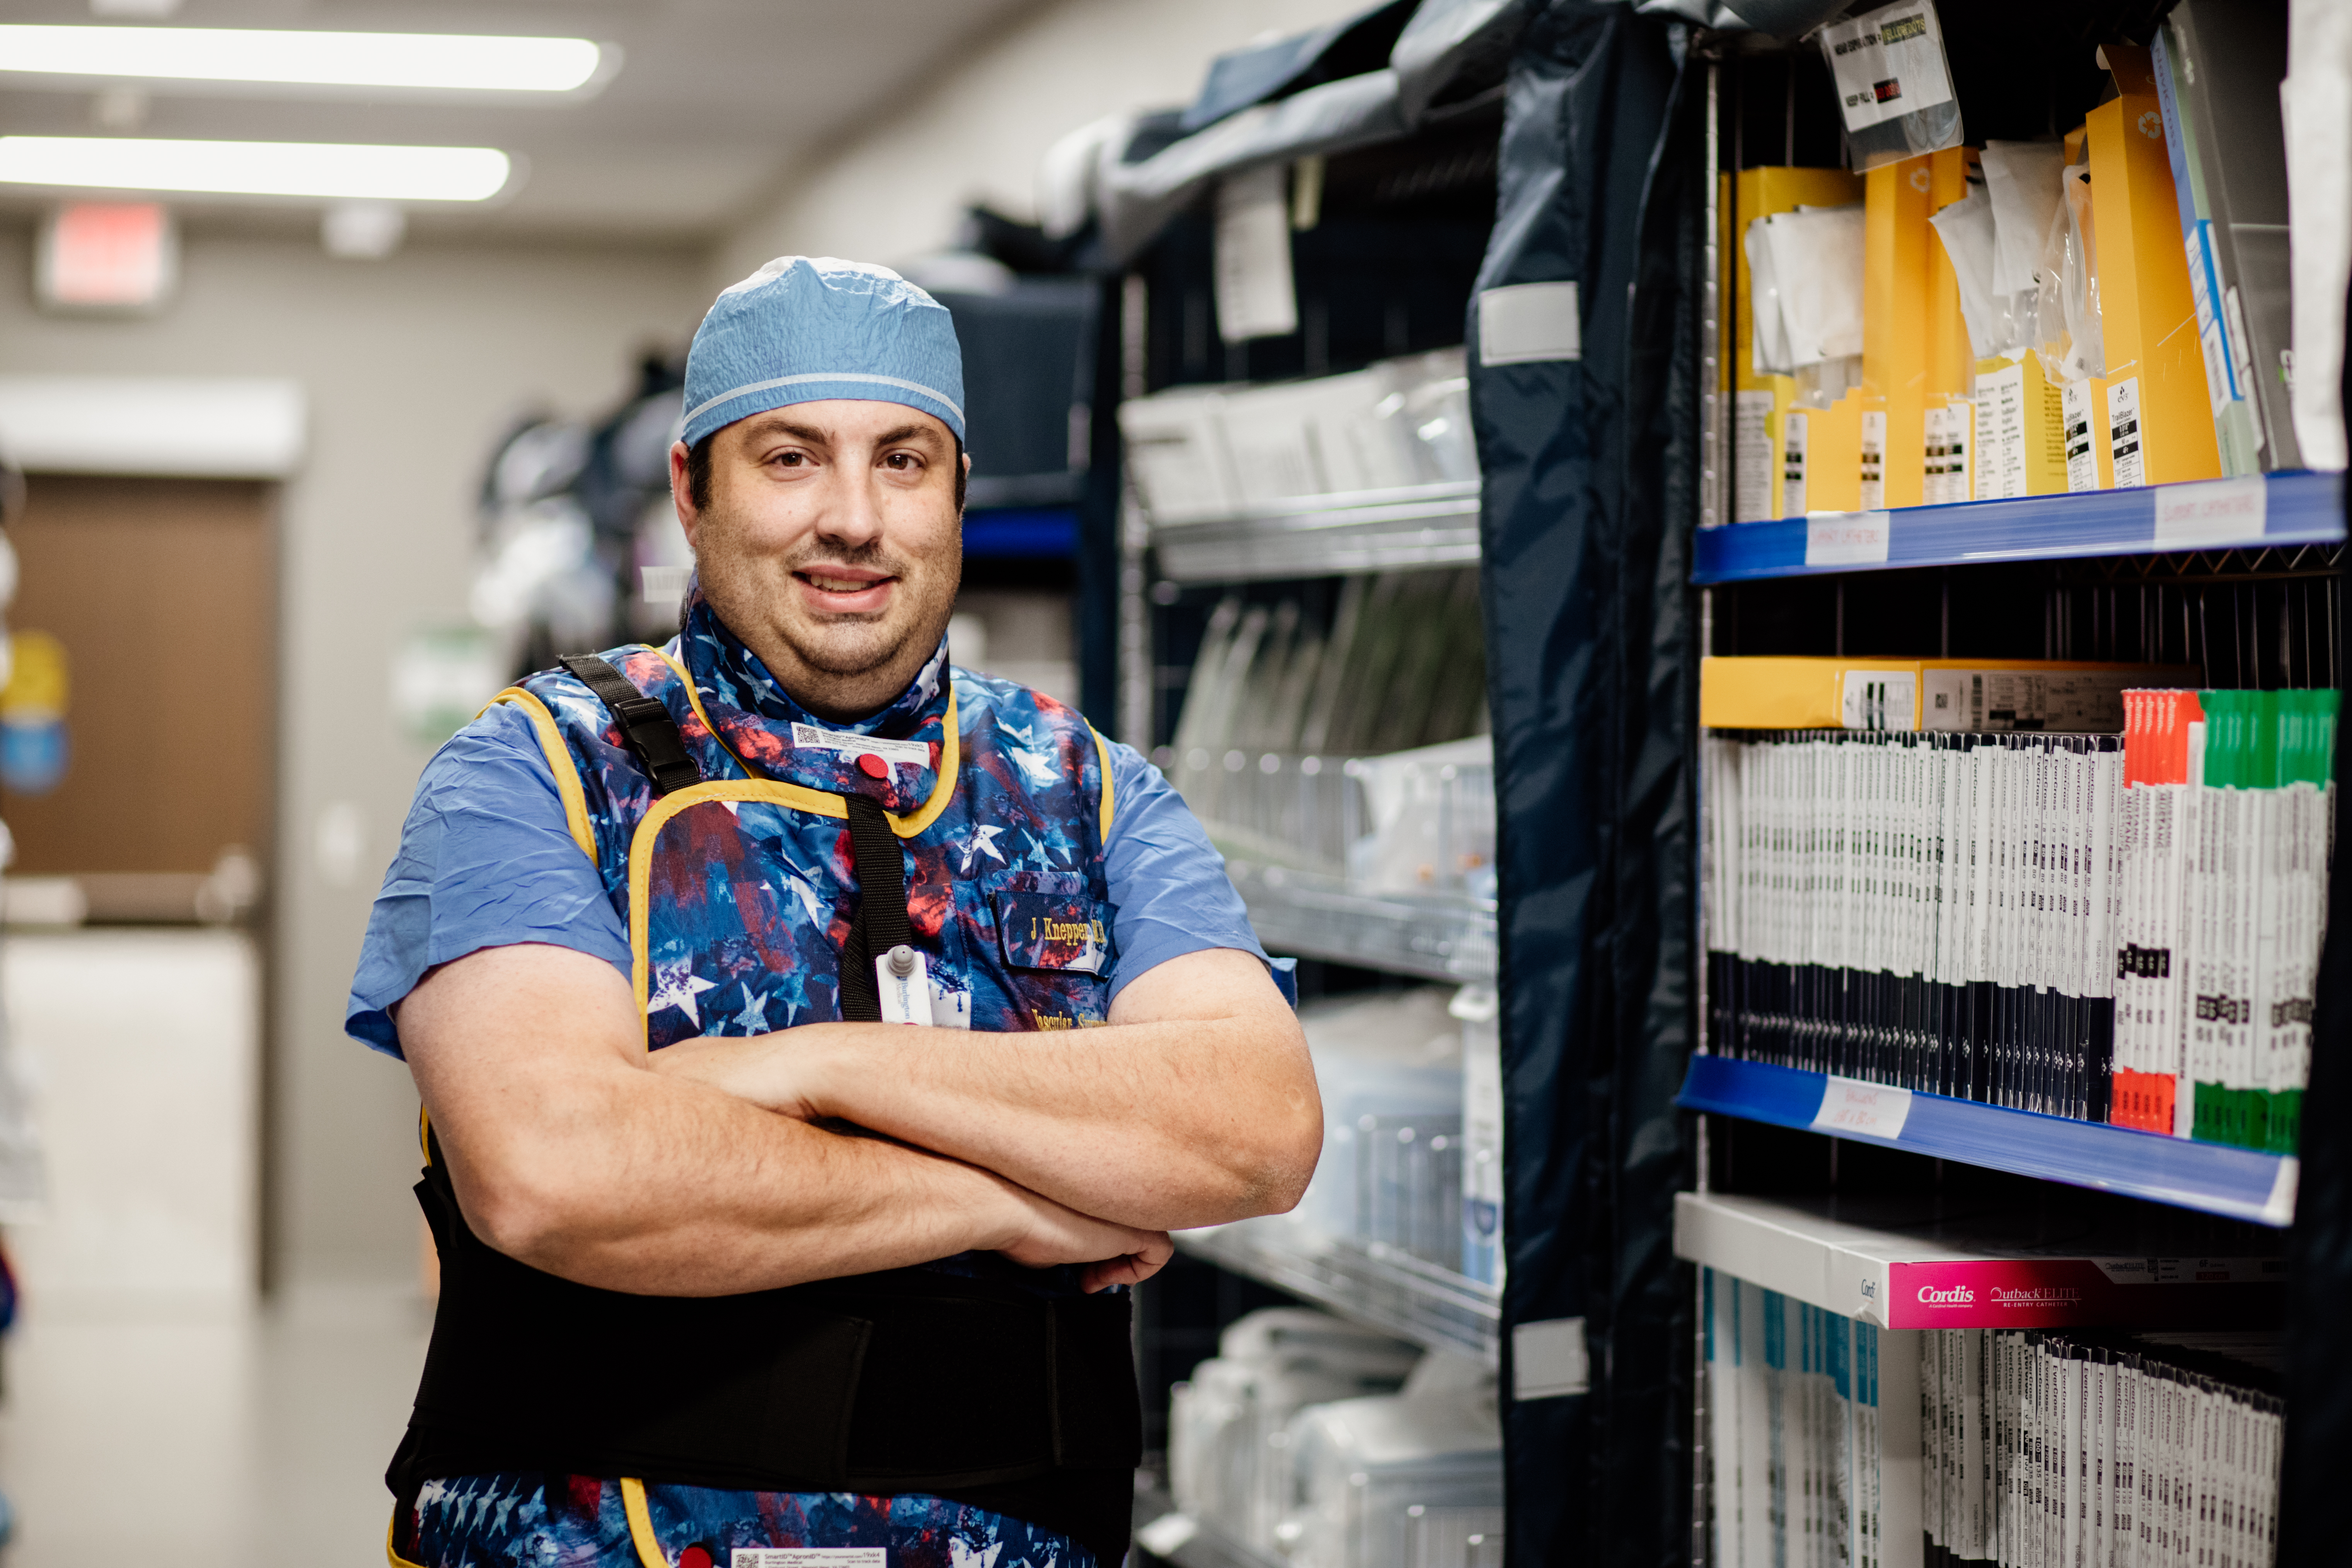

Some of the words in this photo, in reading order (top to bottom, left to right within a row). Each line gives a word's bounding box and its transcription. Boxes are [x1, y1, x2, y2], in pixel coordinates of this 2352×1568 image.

[1031, 917, 1036, 940] J
[901, 983, 910, 1019] Burlington
[1917, 1285, 1974, 1303] Cordis
[2044, 1288, 2079, 1299] ELITE
[2098, 1461, 2102, 1472] 20
